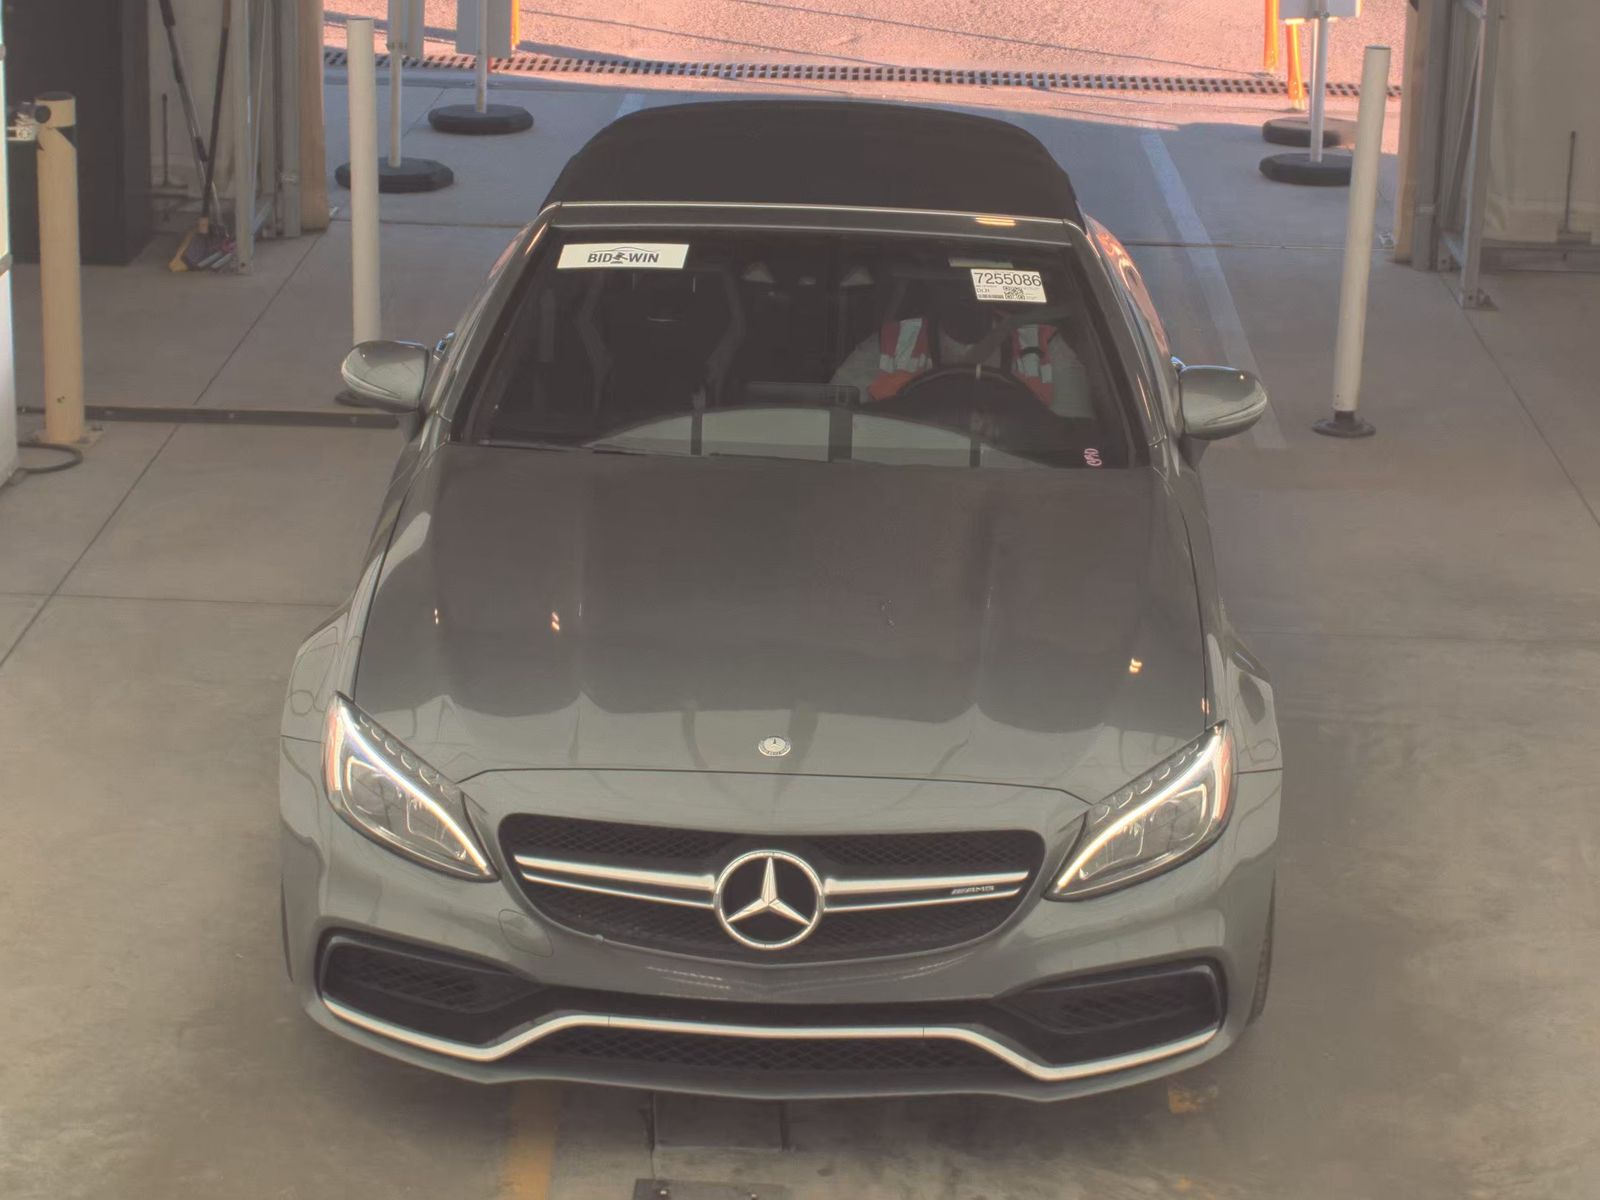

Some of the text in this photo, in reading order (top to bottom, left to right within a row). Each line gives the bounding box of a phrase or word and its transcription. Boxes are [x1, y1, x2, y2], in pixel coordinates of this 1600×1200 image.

[587, 253, 660, 263] BID WIN
[974, 272, 1042, 287] 7255086
